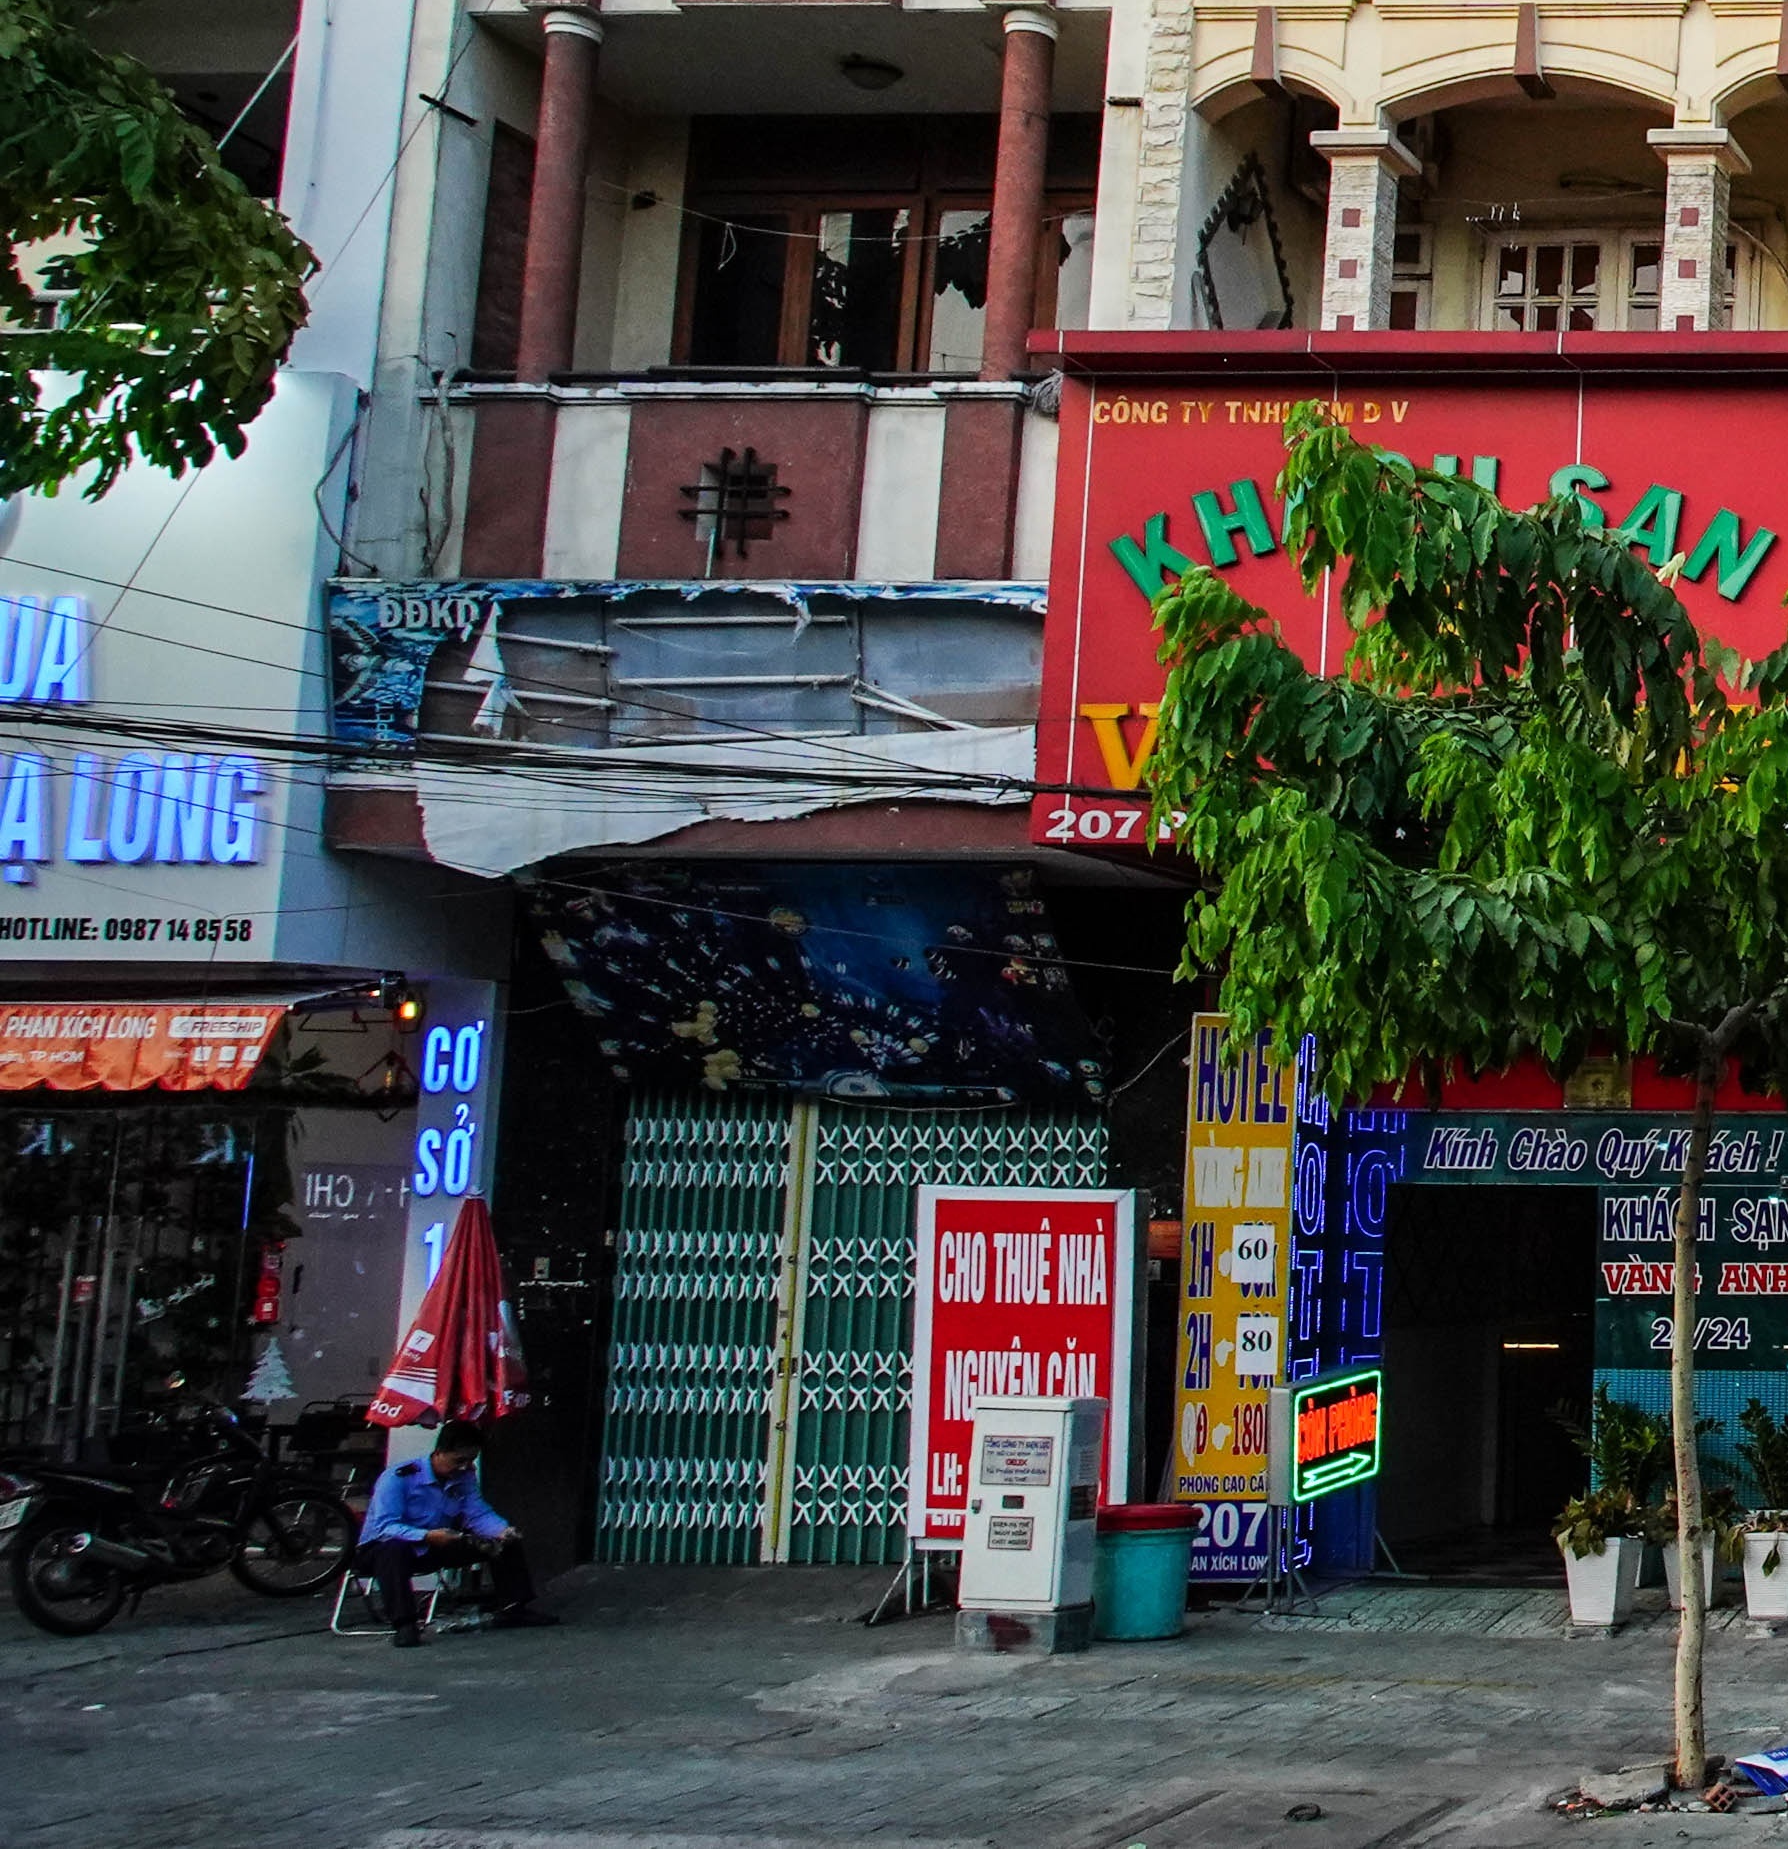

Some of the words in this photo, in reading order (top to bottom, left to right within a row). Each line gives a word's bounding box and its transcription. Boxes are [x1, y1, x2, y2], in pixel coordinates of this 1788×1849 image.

[1093, 395, 1168, 423] CÔNG
[1180, 401, 1215, 423] TY
[65, 751, 260, 864] LONG
[1048, 809, 1142, 840] 207
[0, 918, 97, 941] HOTLINE:
[106, 919, 159, 942] 0987
[4, 1015, 58, 1039] PHAN
[60, 1010, 102, 1039] XÍCH
[106, 1015, 157, 1039] LONG
[422, 1020, 484, 1094] CƠ
[413, 1102, 476, 1199] SỞ
[1424, 1127, 1498, 1170] Kính
[1508, 1127, 1587, 1170] Chào
[1597, 1127, 1661, 1178] Quý
[1660, 1129, 1761, 1172] Kách
[939, 1231, 986, 1304] CHO
[993, 1218, 1052, 1305] THUÊ
[1058, 1218, 1107, 1306] NHÀ
[1188, 1221, 1215, 1298] 1H
[1237, 1238, 1268, 1260] 60
[1184, 1312, 1213, 1389] 2H
[1241, 1330, 1272, 1352] 80
[1651, 1317, 1751, 1350] 2/24
[944, 1336, 1040, 1422] NGUYÊN
[1047, 1337, 1097, 1398] CĂN
[1231, 1402, 1268, 1456] 180
[932, 1452, 962, 1496] LH:
[1222, 1475, 1246, 1494] CAO
[1192, 1502, 1268, 1548] 207
[1190, 1554, 1208, 1571] AN
[1241, 1554, 1268, 1571] LON
